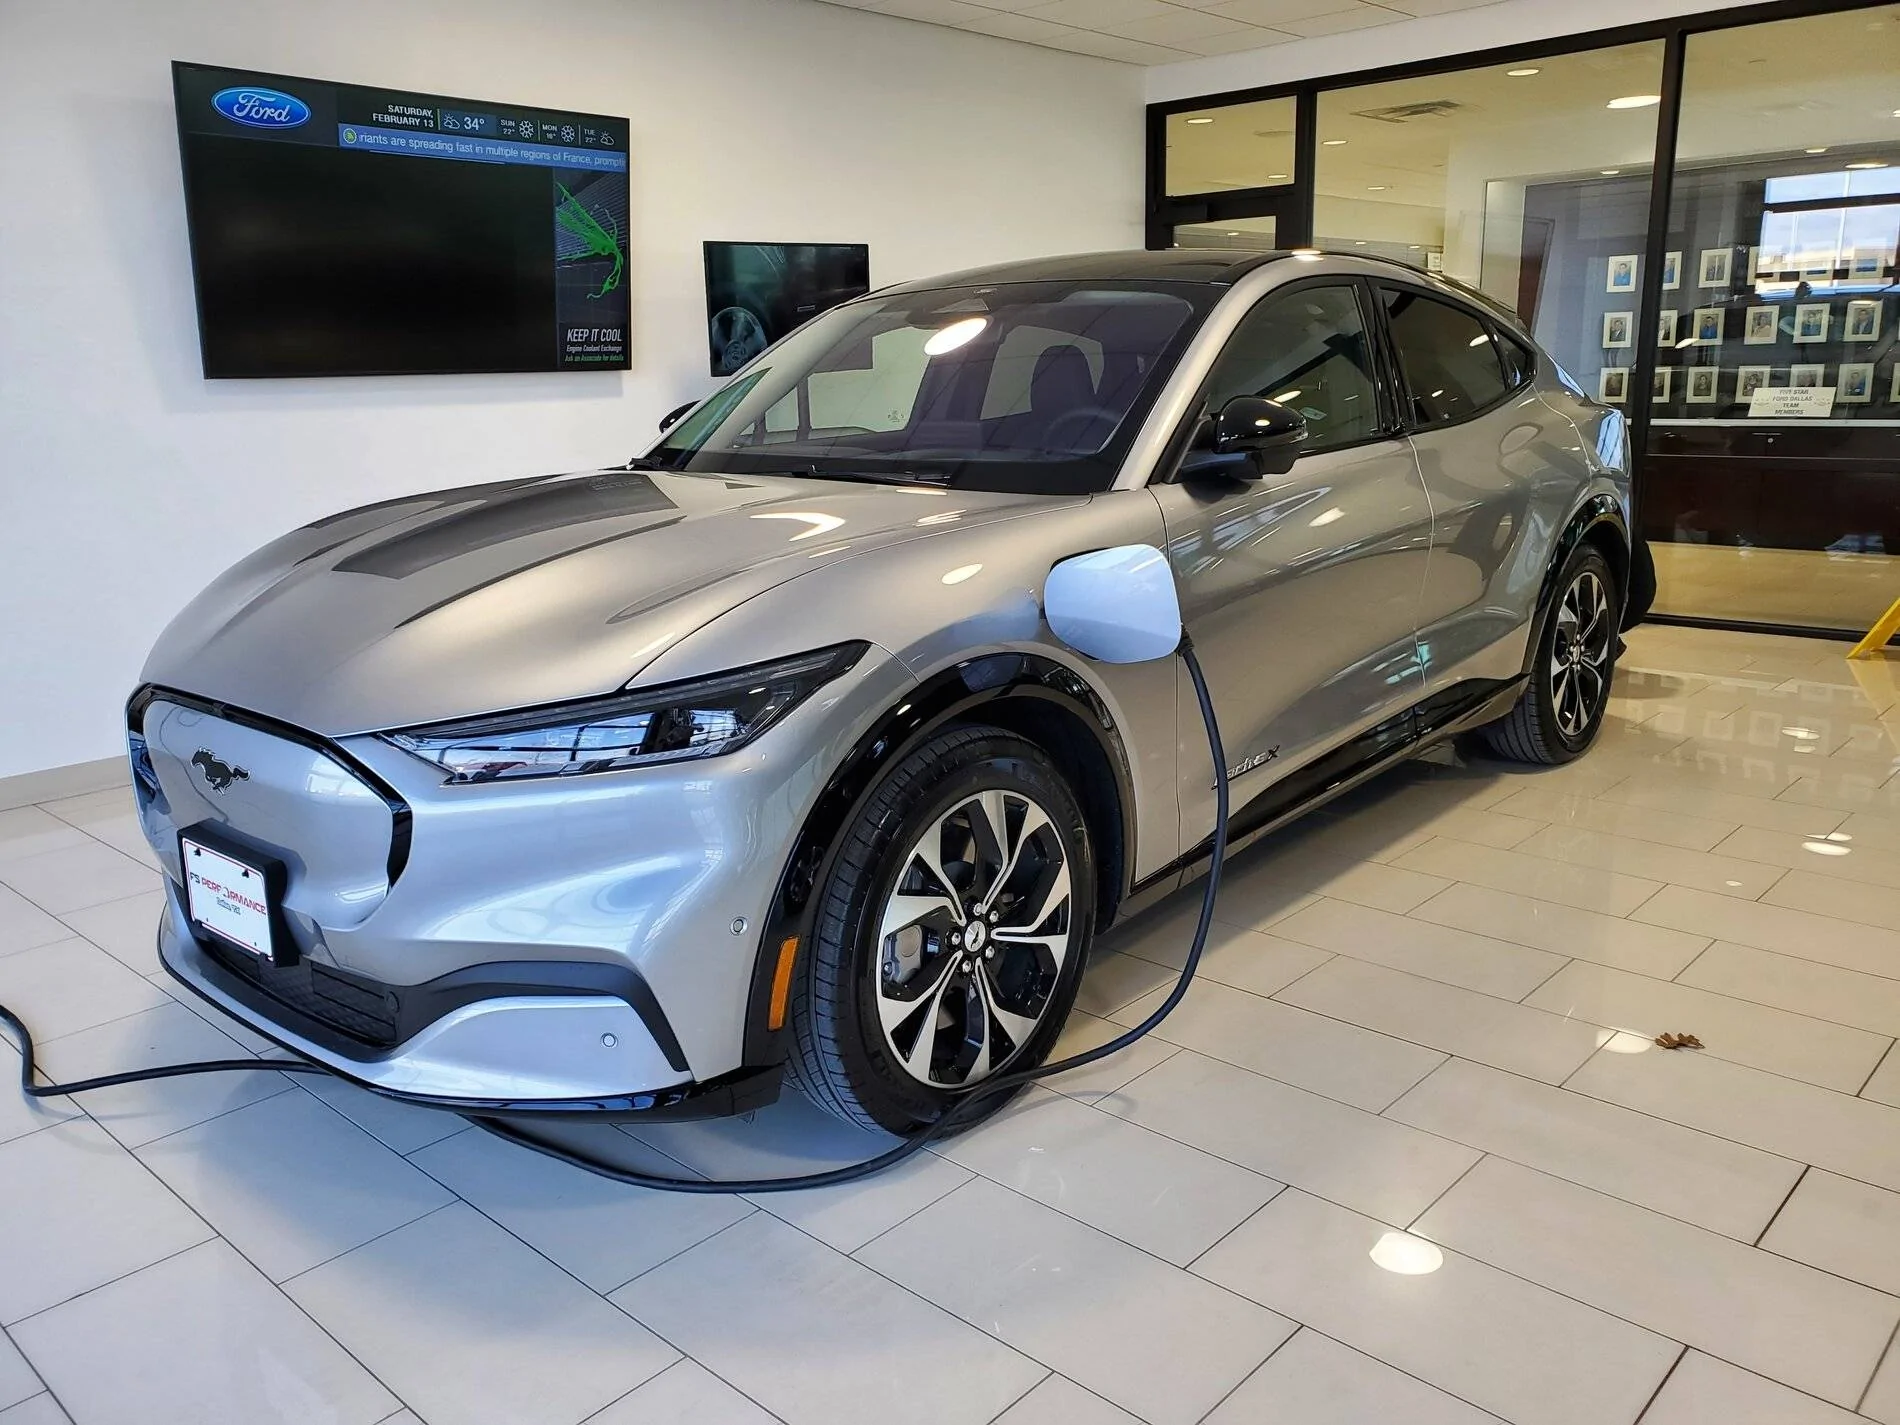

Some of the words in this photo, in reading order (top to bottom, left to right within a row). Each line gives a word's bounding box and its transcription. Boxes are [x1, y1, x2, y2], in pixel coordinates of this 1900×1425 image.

[233, 92, 290, 122] Ford
[388, 104, 434, 118] SATURDAY,
[372, 112, 420, 126] FEBRUARY
[423, 119, 434, 128] 13
[500, 119, 515, 127] SUN
[542, 124, 558, 132] MON
[584, 128, 596, 136] TUE
[391, 137, 406, 147] are
[409, 138, 453, 152] spreading
[456, 143, 473, 153] fast
[475, 144, 484, 154] in
[486, 146, 518, 158] multiple
[520, 149, 551, 161] regions
[553, 152, 562, 161] of
[567, 328, 589, 342] KEEP
[591, 328, 600, 342] IT
[600, 328, 622, 342] COOL
[190, 871, 201, 884] FS
[202, 877, 266, 915] PERFORMANCE
